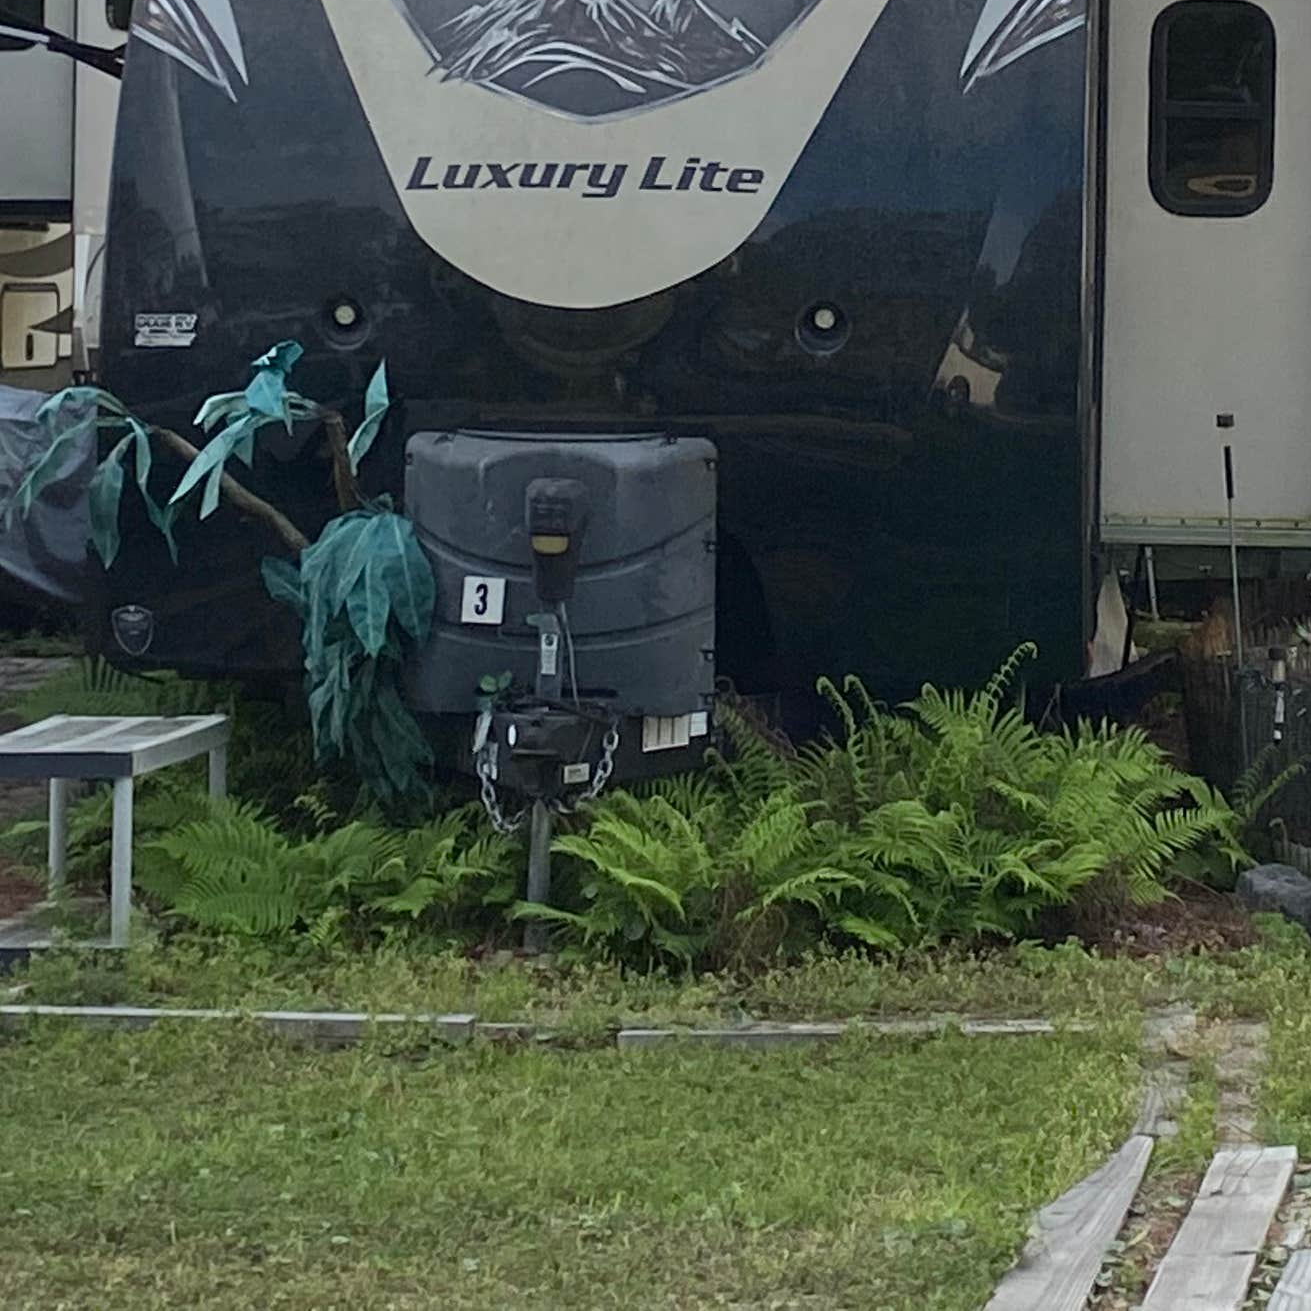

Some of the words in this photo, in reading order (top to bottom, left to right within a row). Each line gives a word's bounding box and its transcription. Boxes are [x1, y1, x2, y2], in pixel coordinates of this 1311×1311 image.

[405, 156, 629, 199] Luxury
[639, 156, 765, 194] Lite
[473, 582, 489, 616] 3
